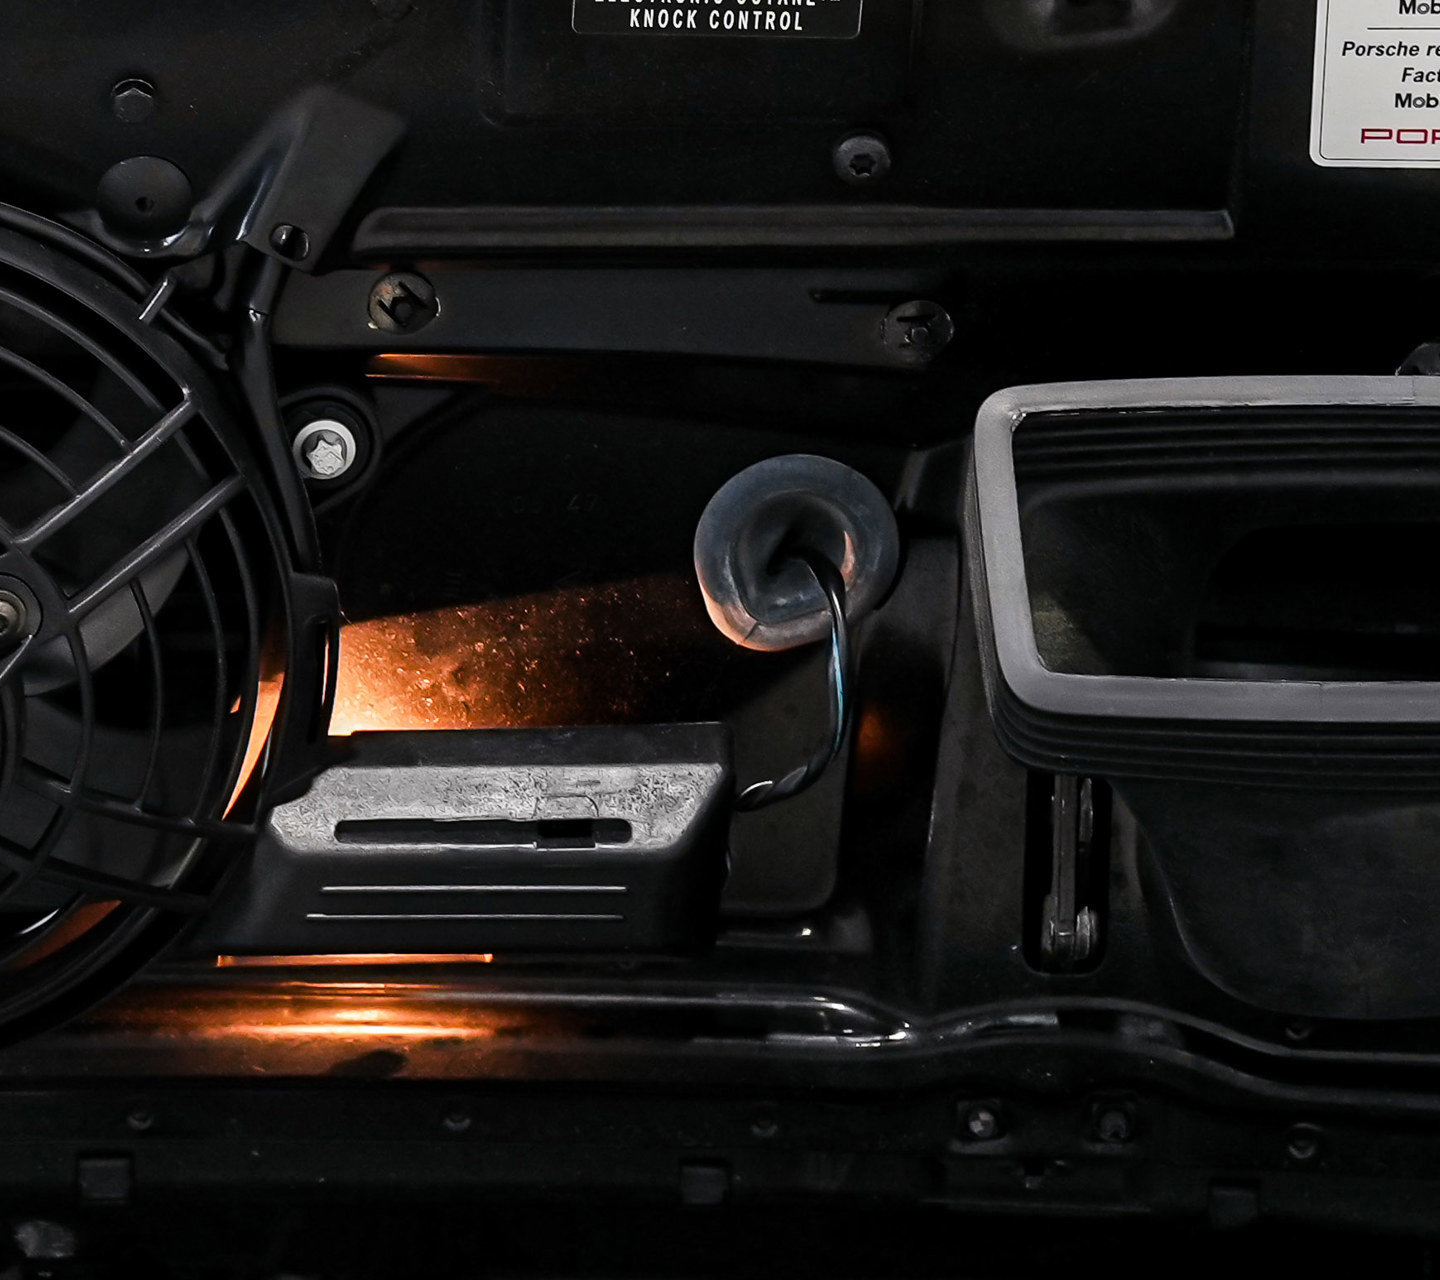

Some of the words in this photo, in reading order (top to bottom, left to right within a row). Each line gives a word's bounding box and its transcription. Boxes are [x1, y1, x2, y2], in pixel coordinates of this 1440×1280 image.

[630, 9, 697, 28] KNOCK
[710, 10, 802, 30] CONTROL
[1342, 41, 1419, 56] Porsche
